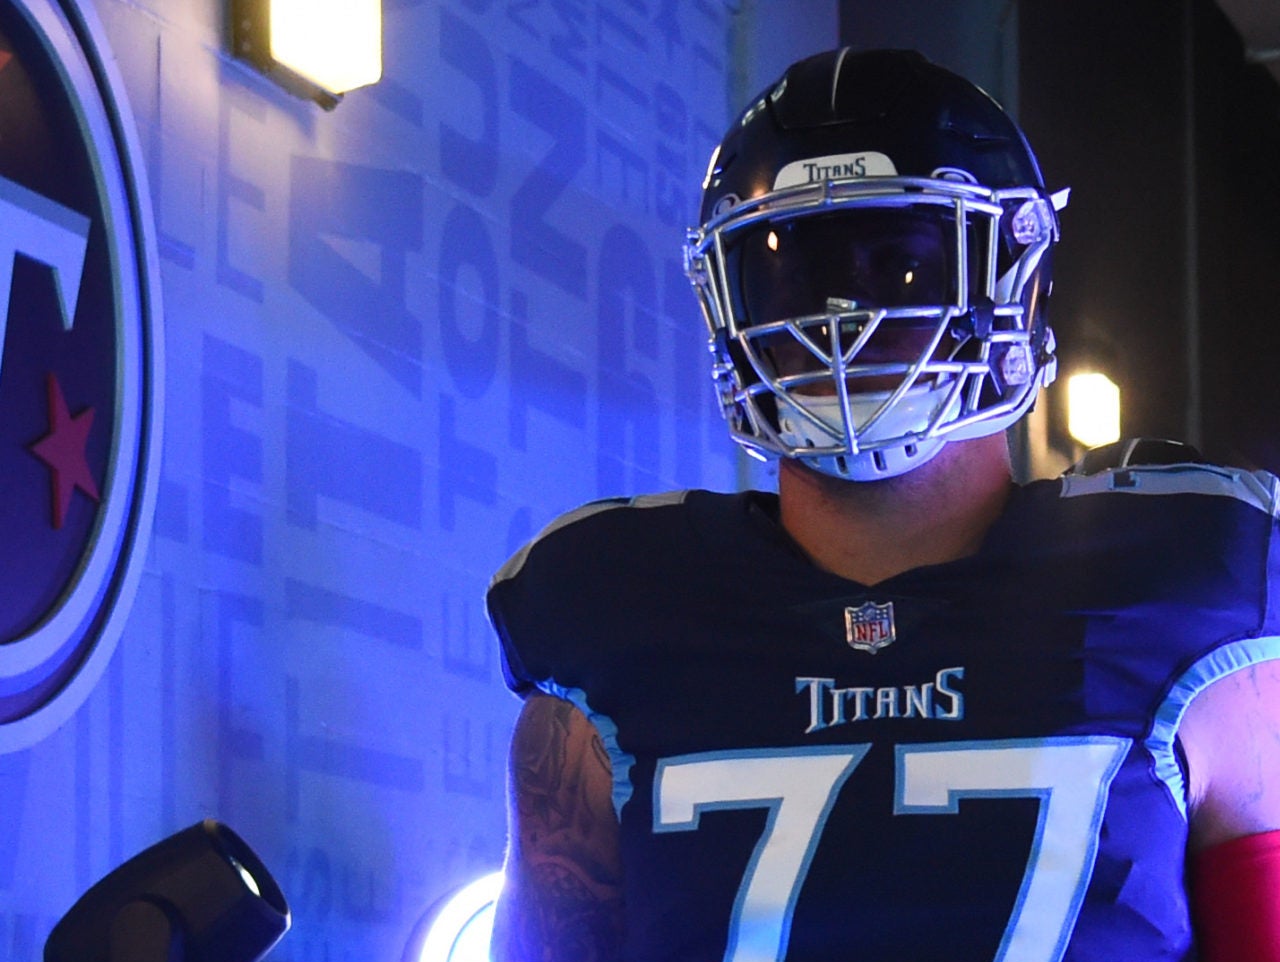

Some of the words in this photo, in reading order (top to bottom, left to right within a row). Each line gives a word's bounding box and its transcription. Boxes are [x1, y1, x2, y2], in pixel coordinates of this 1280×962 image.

[803, 156, 866, 183] TITANS
[855, 621, 889, 642] NFL
[794, 666, 966, 734] TITANS
